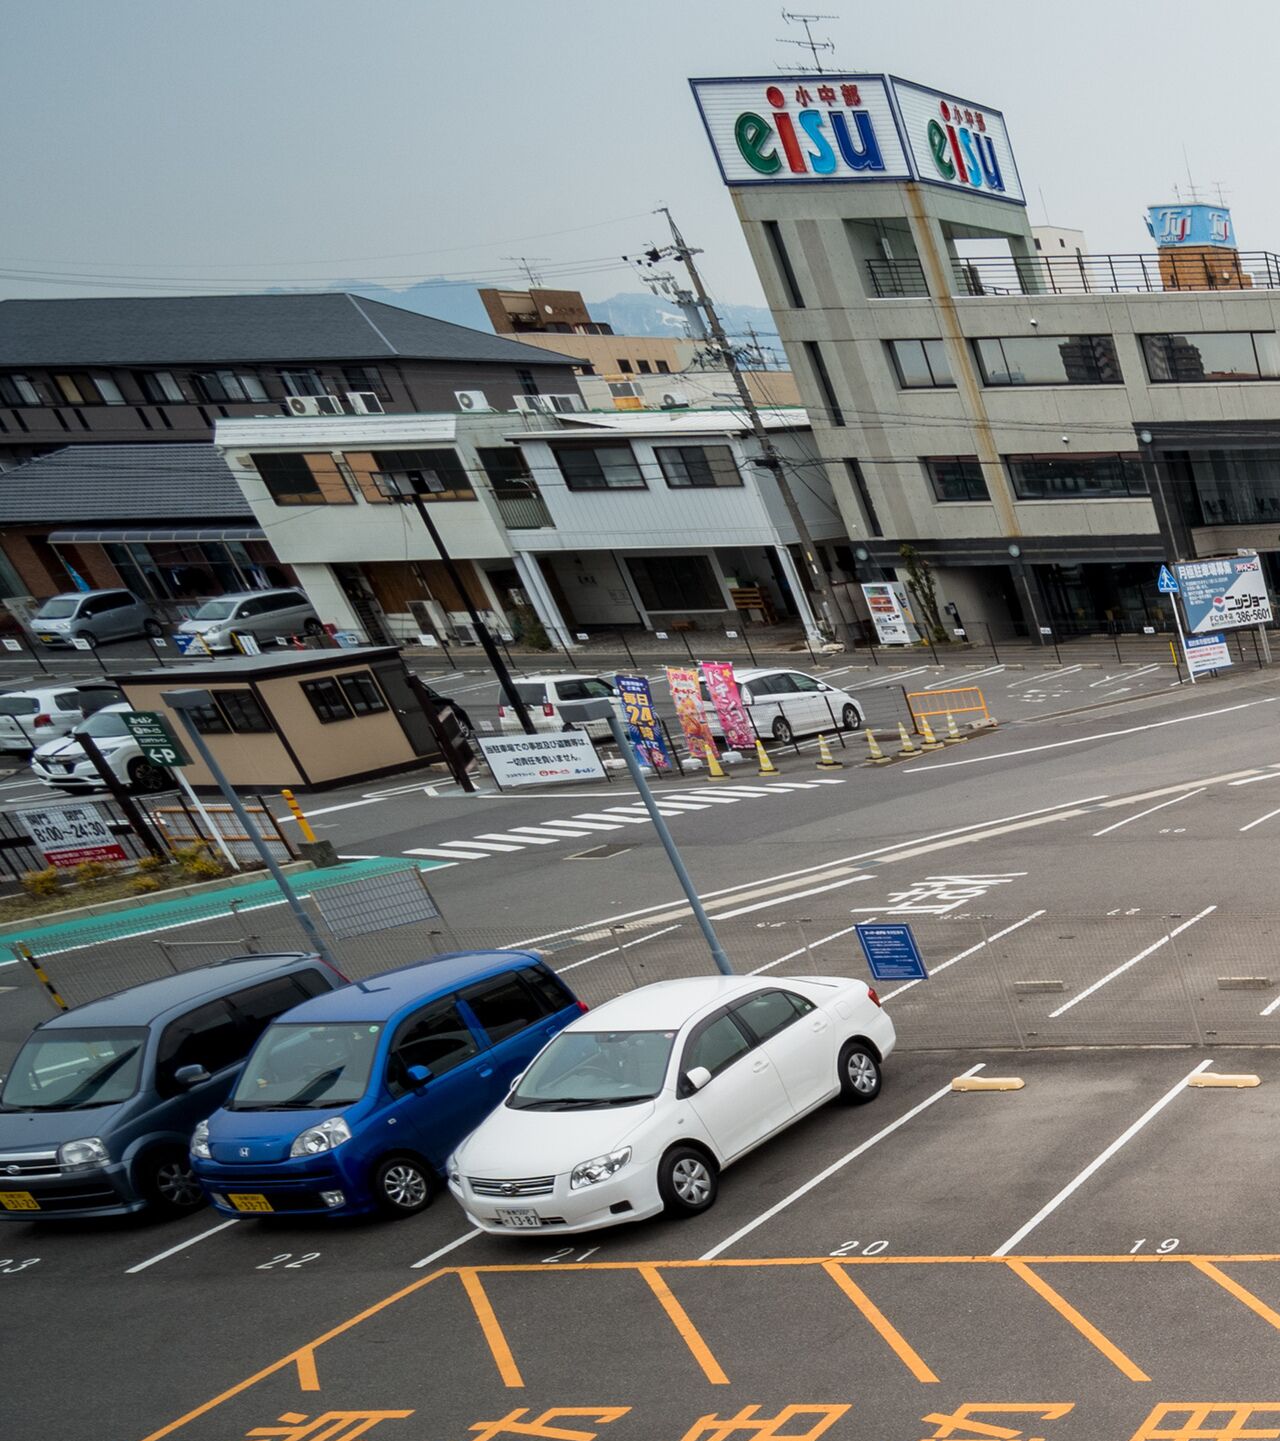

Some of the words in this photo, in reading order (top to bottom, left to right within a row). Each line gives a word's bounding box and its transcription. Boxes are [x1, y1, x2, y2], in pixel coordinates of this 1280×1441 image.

[734, 86, 886, 175] eisu
[927, 100, 1006, 189] eisu
[542, 1246, 600, 1264] 21
[830, 1240, 890, 1257] 20
[1130, 1238, 1180, 1254] 19
[255, 1252, 321, 1270] 22
